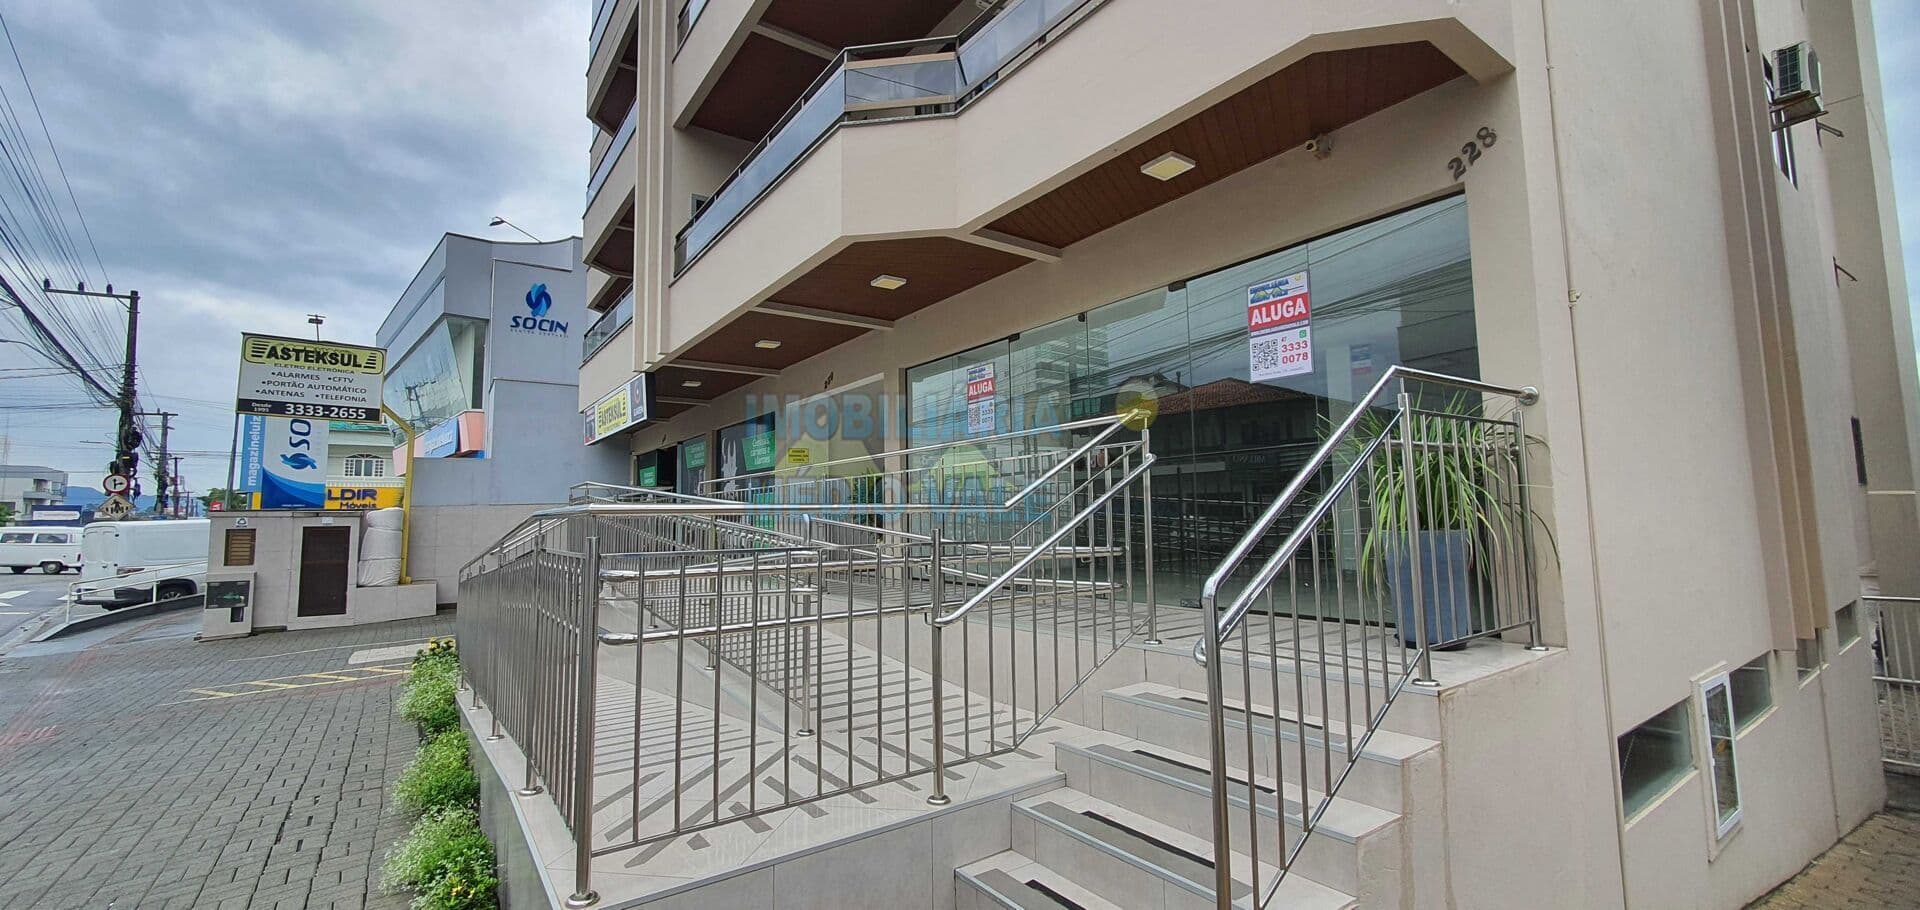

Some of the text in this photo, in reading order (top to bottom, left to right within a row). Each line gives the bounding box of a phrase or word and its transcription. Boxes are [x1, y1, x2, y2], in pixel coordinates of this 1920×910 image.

[1447, 126, 1497, 181] 228
[1250, 297, 1306, 326] ALUGA
[510, 315, 569, 334] SOCIN
[1281, 340, 1309, 353] 3333
[266, 345, 362, 369] ASTEKSUL
[1281, 352, 1309, 365] 0078
[274, 363, 305, 371] ELETRO
[275, 371, 354, 384] ALARMES CFTV
[266, 379, 367, 395] PORTÃO AUTOMÁTICO
[968, 380, 993, 397] ALUGA
[260, 388, 367, 403] ANTENAS TELEFONIA
[285, 402, 367, 420] 3333-2655
[327, 488, 378, 501] LDIR
